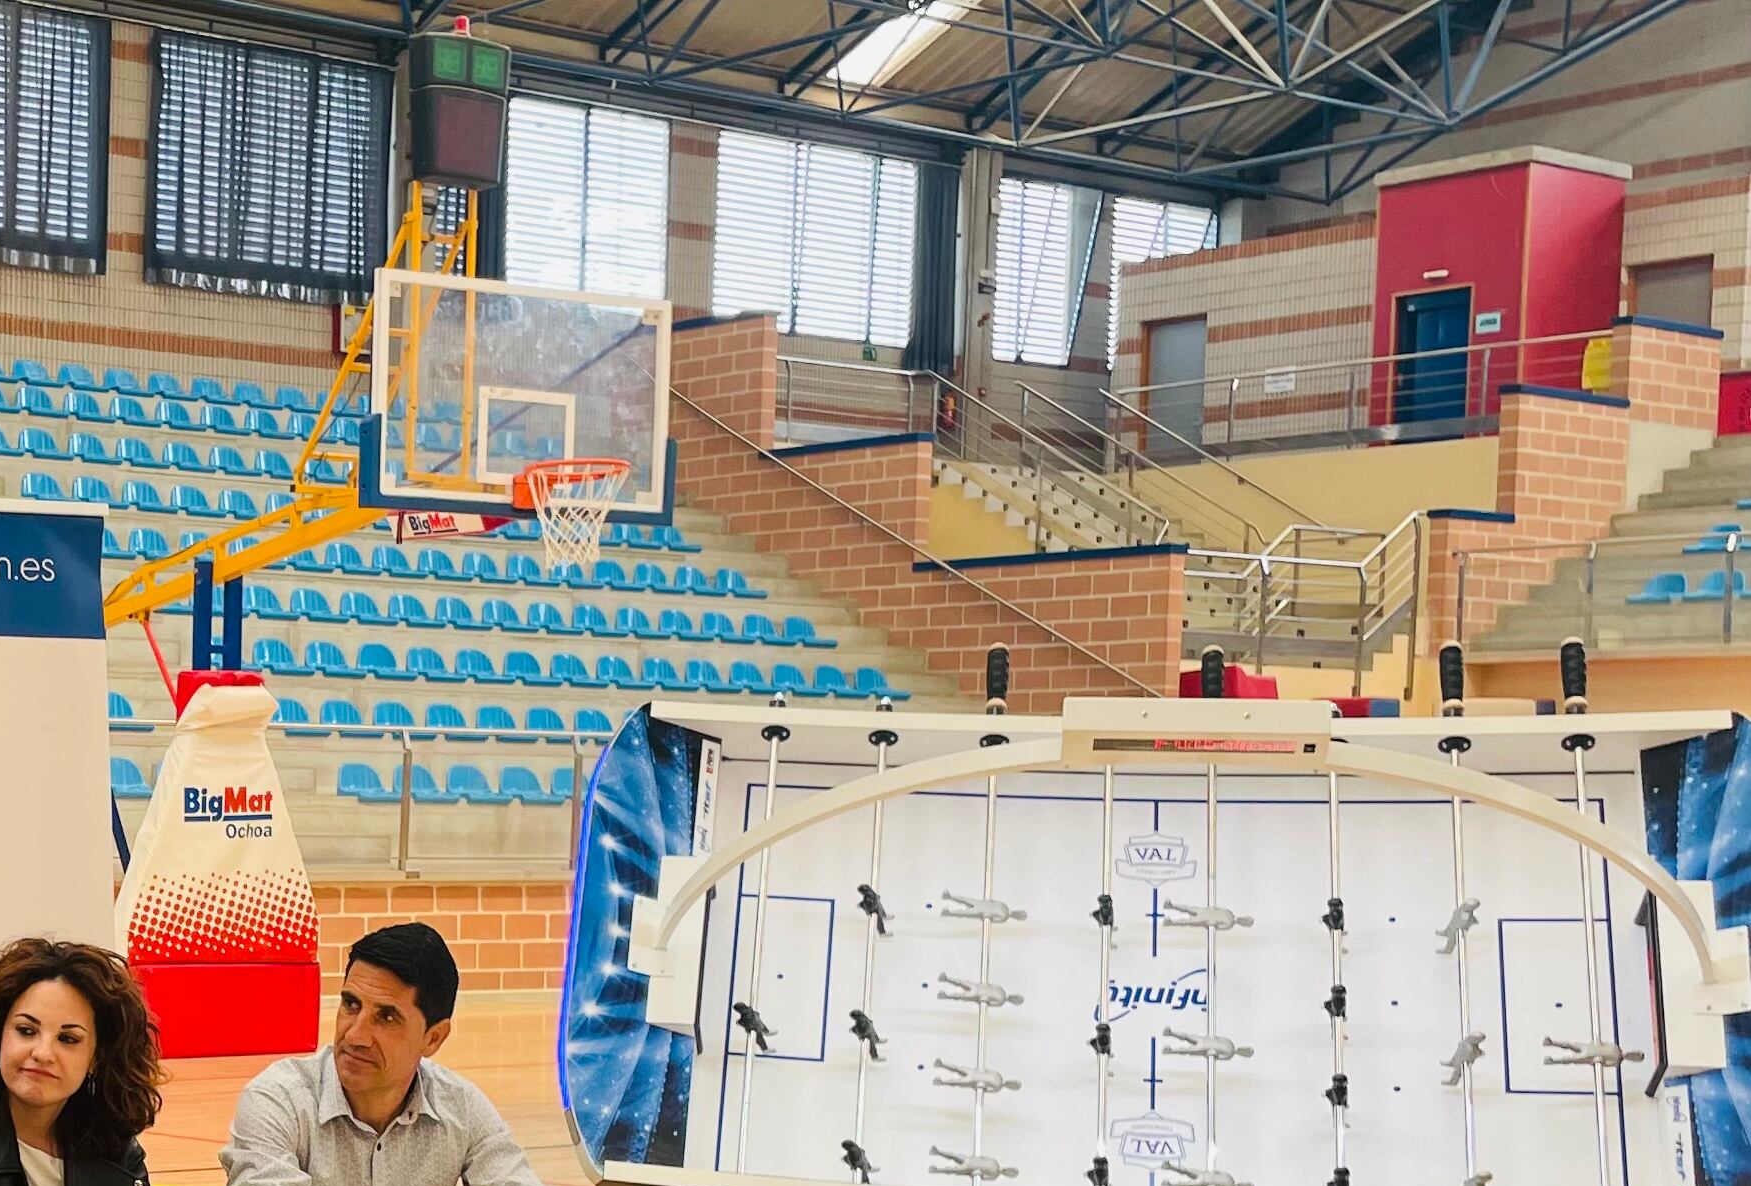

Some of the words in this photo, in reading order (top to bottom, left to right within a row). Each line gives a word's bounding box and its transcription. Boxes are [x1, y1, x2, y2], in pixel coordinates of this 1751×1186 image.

[408, 512, 456, 534] BigMat
[184, 787, 273, 822] BigMat
[225, 824, 273, 839] Ochoa
